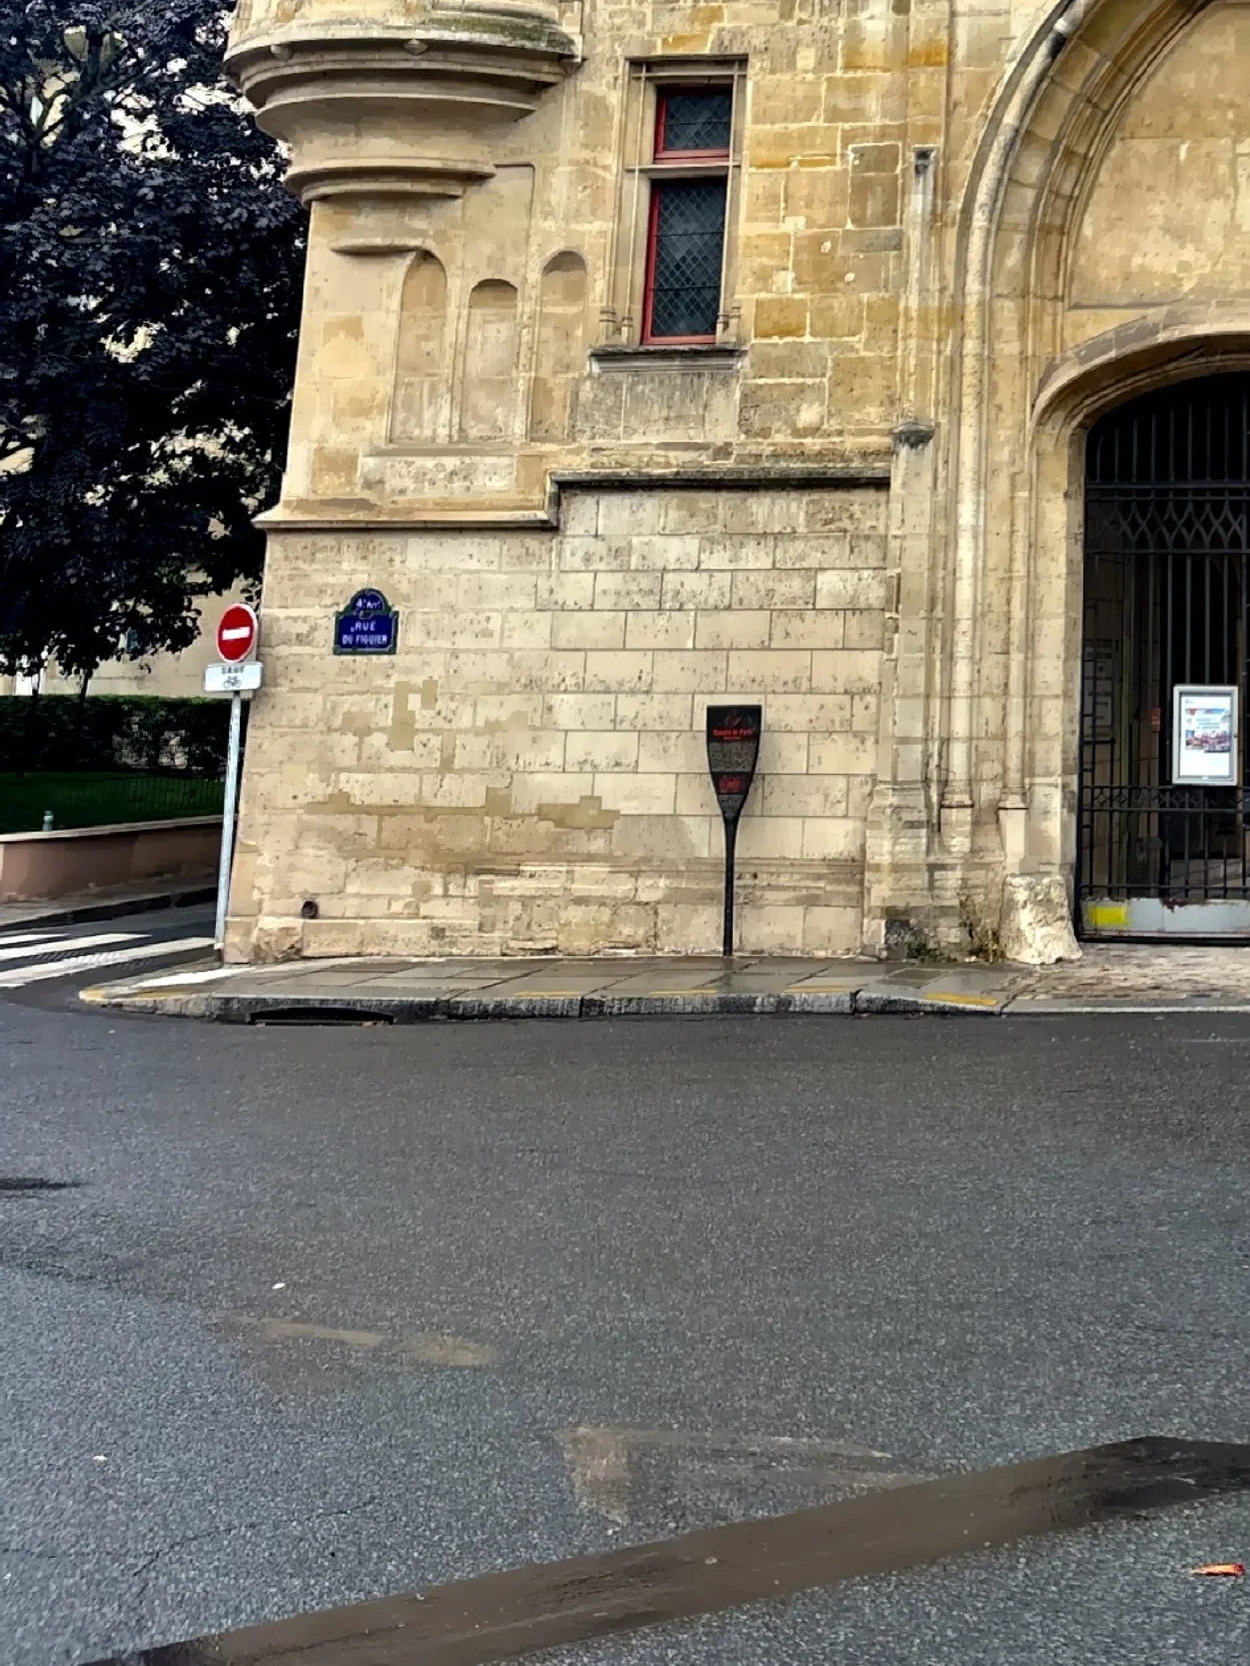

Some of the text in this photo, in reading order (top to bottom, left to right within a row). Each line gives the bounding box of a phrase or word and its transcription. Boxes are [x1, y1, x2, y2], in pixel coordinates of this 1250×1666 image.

[354, 620, 377, 632] RUE
[342, 634, 388, 645] DU FIGUIER
[221, 665, 246, 675] SAUF
